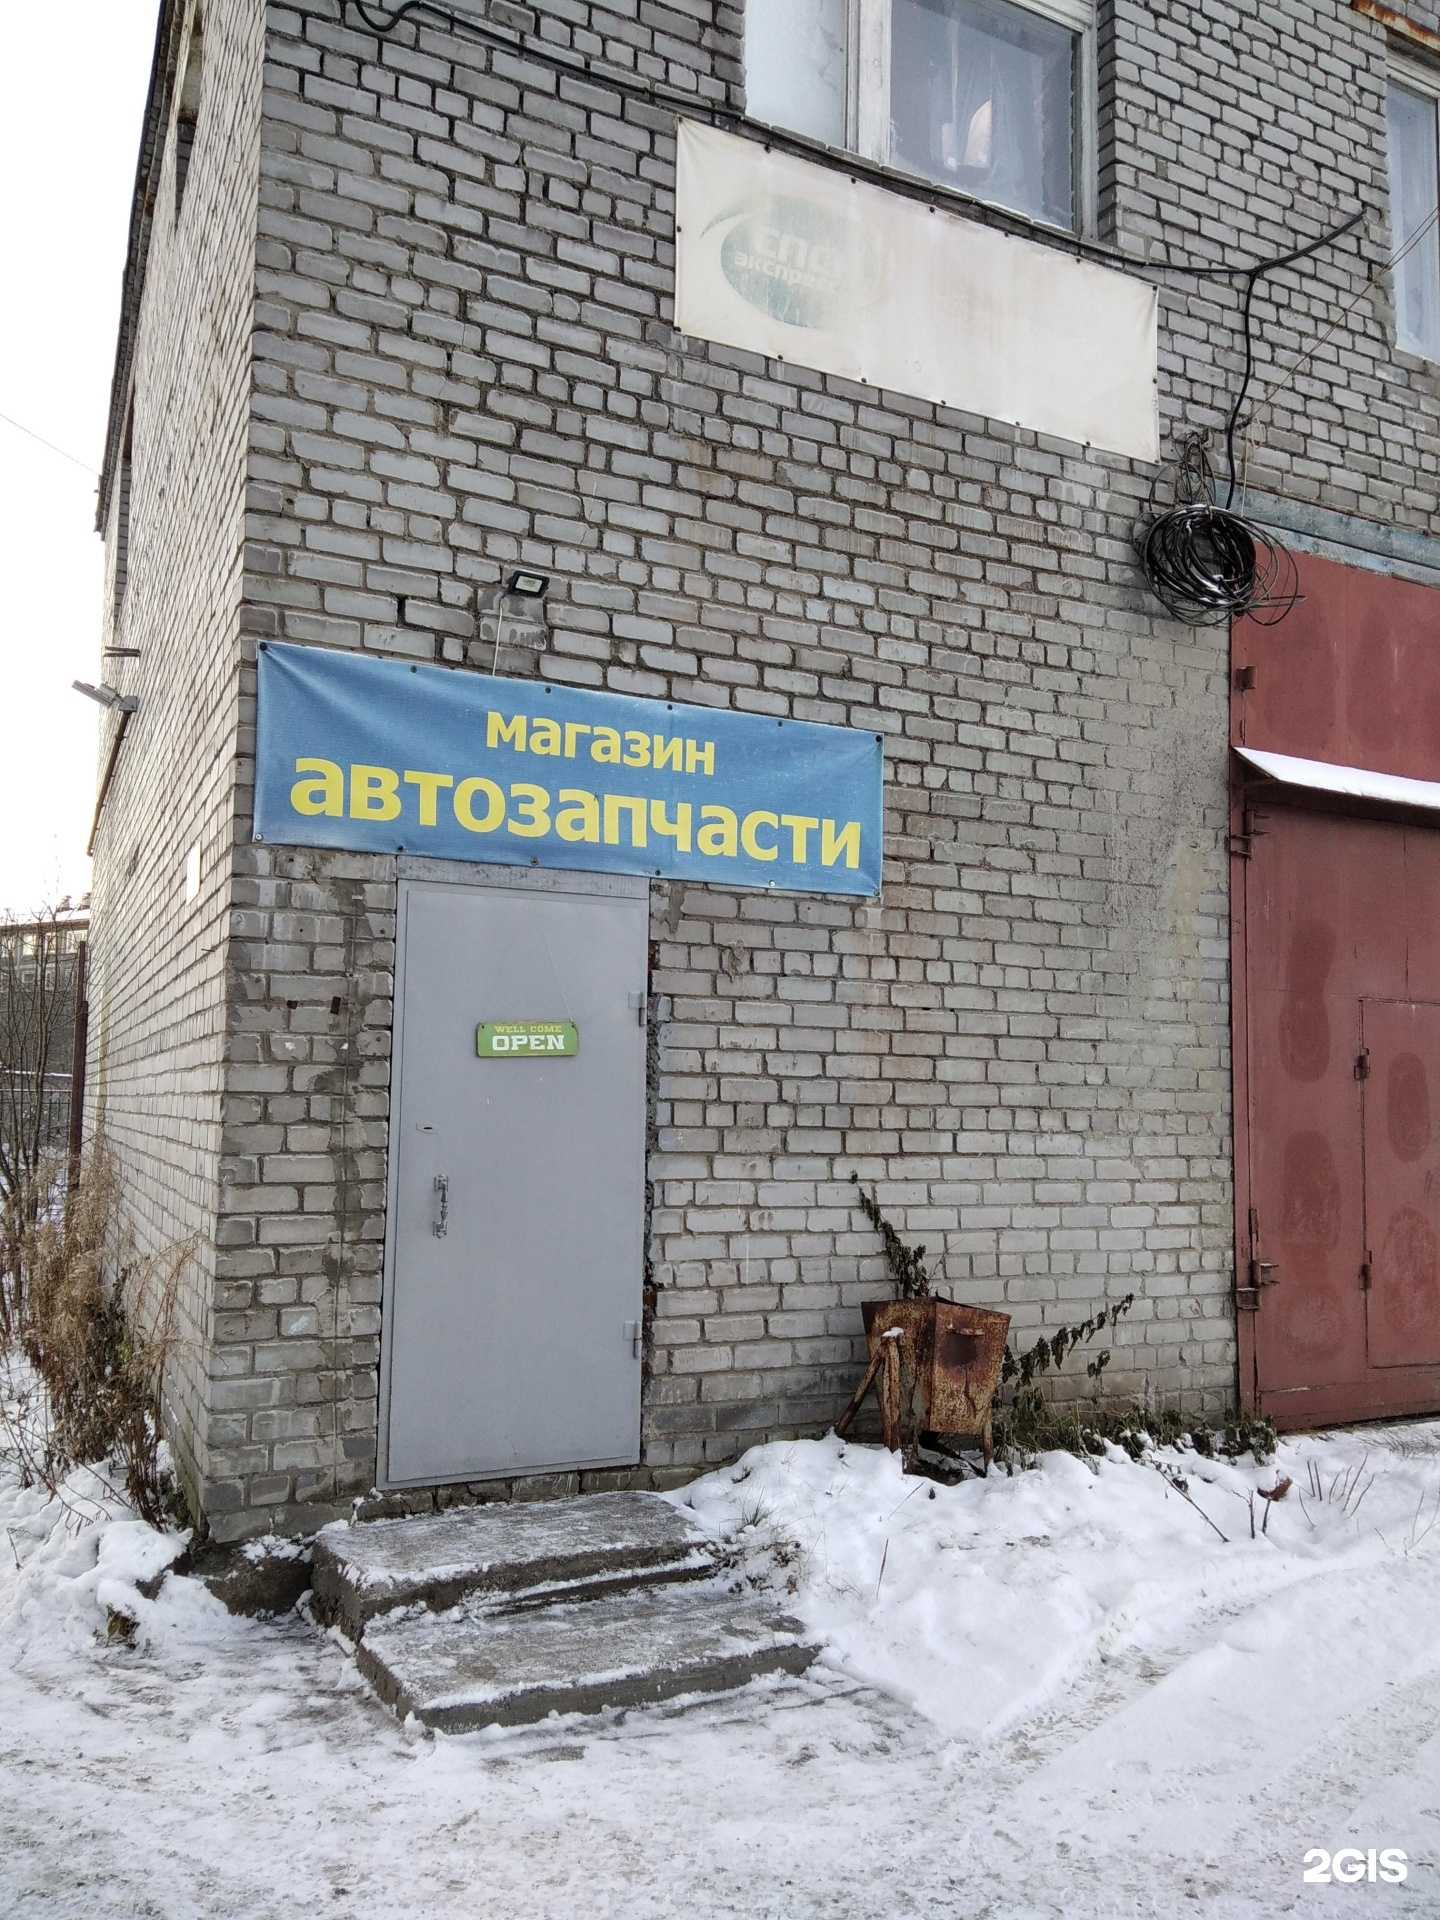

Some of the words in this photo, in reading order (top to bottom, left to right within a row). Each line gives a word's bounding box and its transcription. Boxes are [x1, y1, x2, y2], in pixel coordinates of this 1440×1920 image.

[487, 711, 715, 775] магазин
[290, 758, 861, 868] автозапчасти
[492, 1035, 565, 1051] OPEN
[494, 1024, 526, 1033] WELL
[530, 1024, 562, 1033] COME
